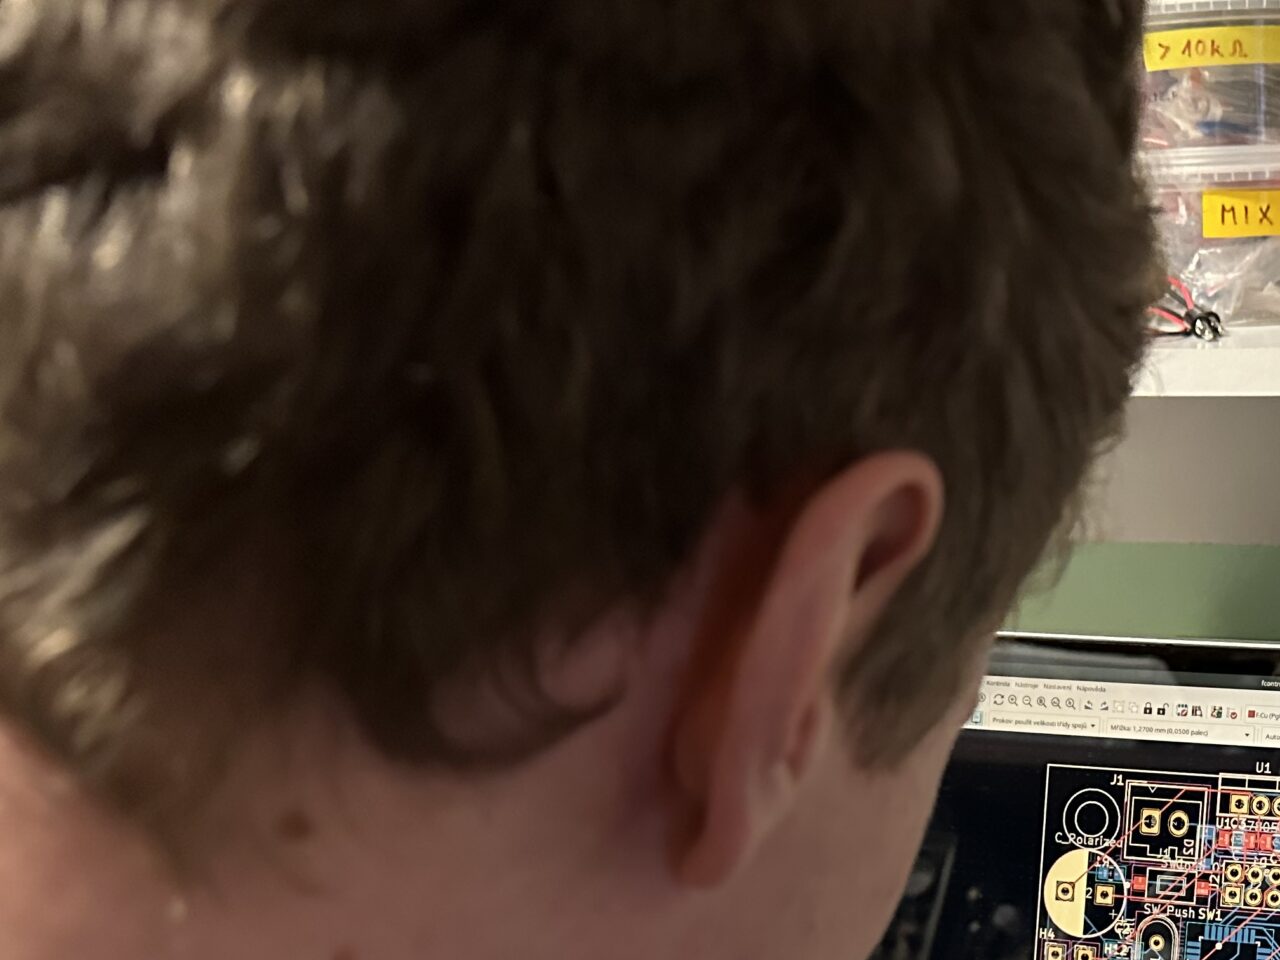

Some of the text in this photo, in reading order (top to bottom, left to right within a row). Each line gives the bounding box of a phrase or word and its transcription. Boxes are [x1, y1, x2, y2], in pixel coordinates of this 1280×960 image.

[1220, 203, 1274, 226] MIX
[1255, 762, 1272, 774] U1
[1110, 774, 1124, 786] J1
[1198, 908, 1222, 922] SW1
[1039, 928, 1055, 940] H4
